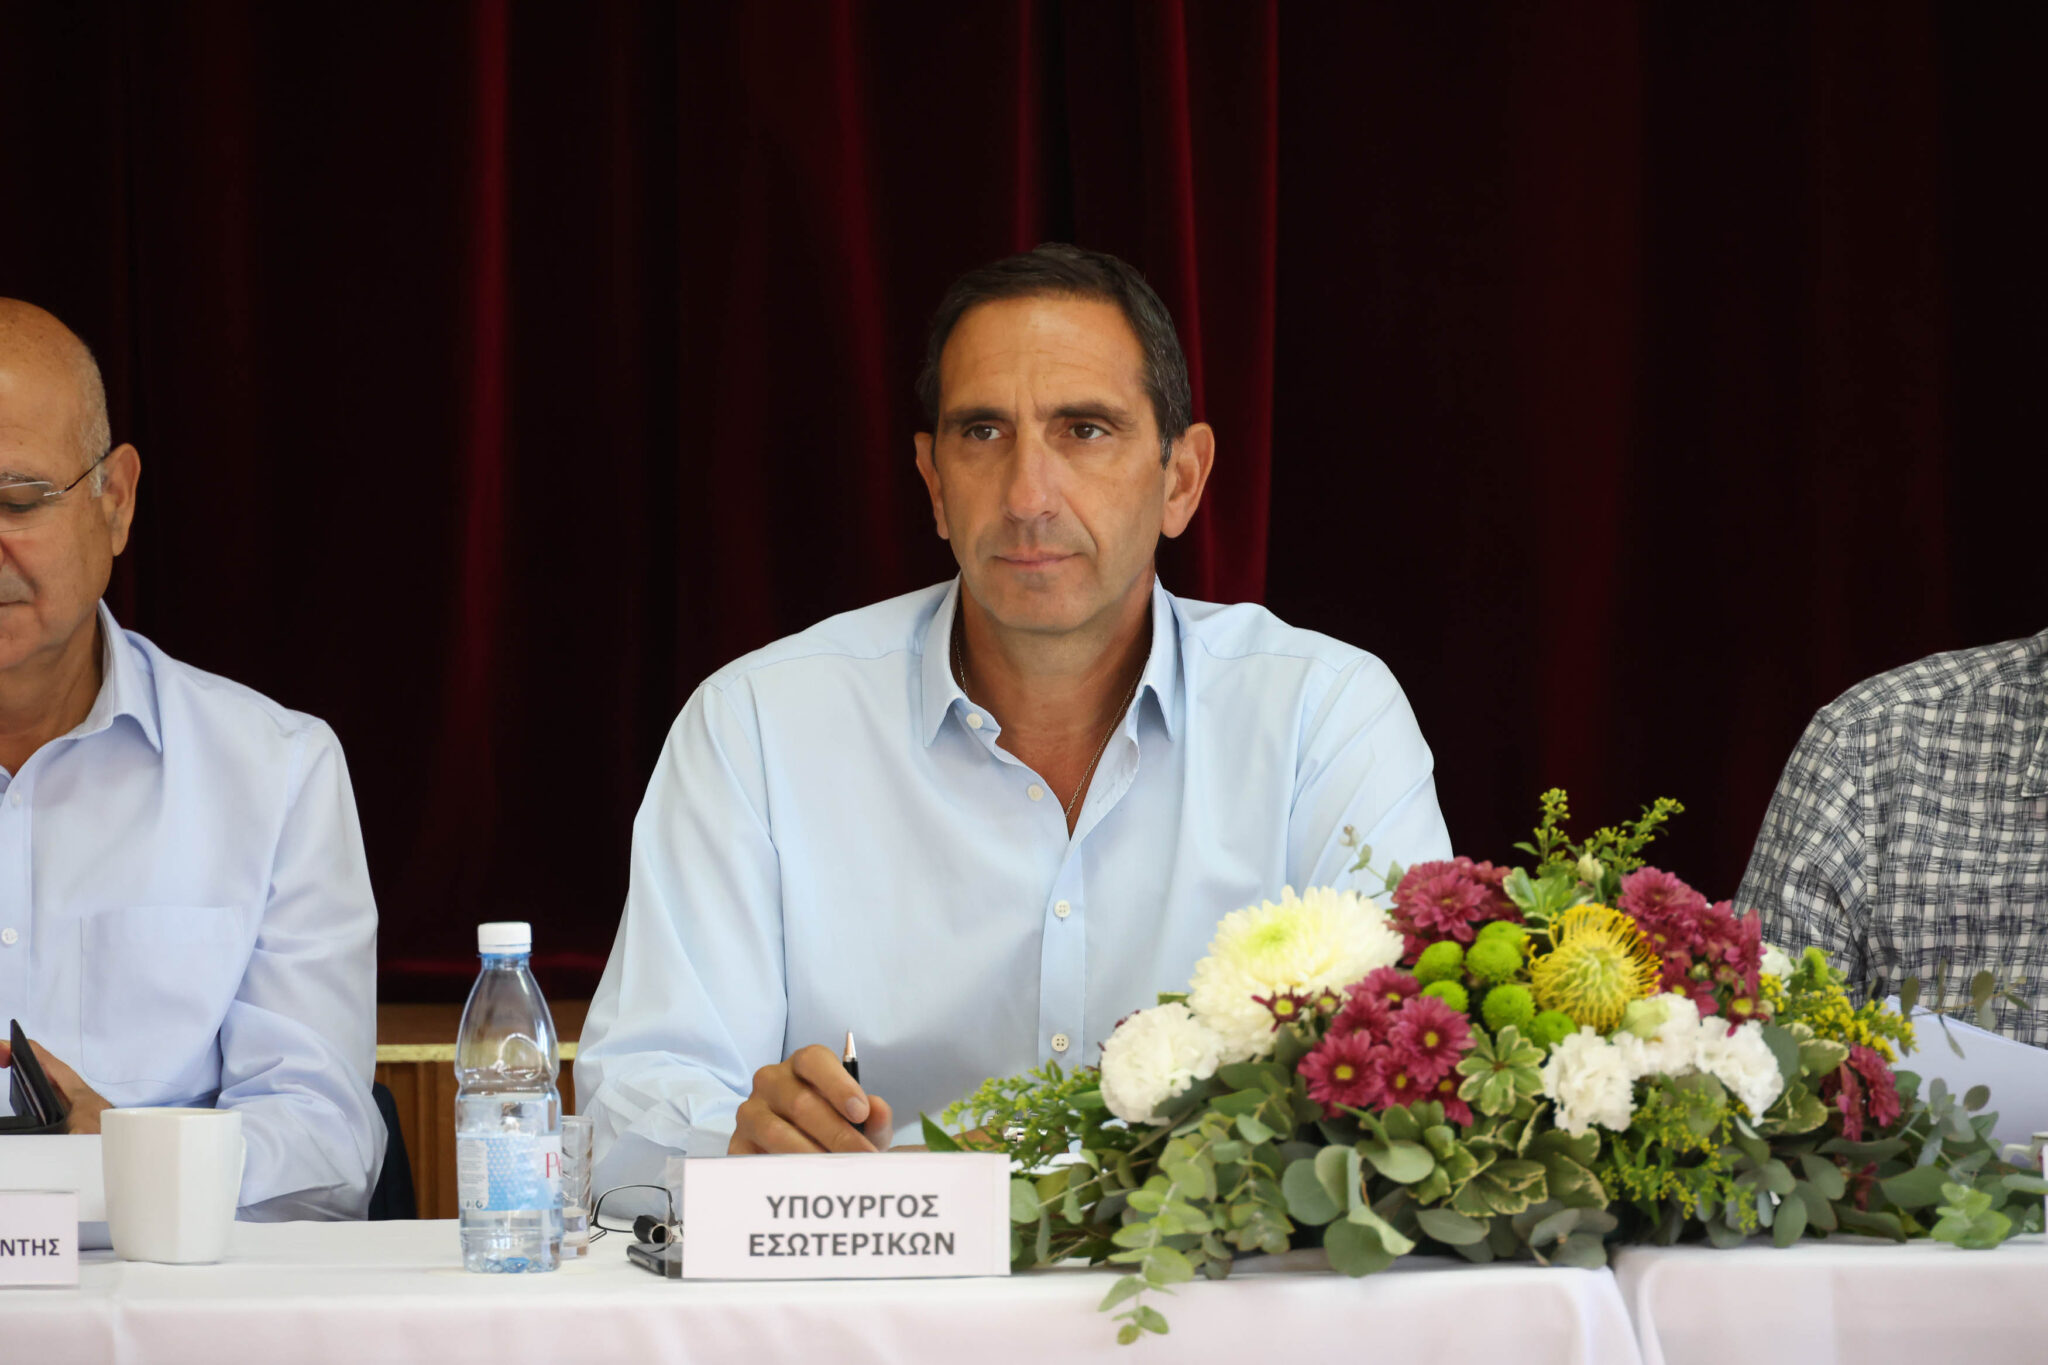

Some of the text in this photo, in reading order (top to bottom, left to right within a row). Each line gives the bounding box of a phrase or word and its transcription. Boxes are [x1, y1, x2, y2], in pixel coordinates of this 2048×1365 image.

[766, 1194, 939, 1219] ΥΠΟΥΡΓΟΣ
[0, 1238, 60, 1256] ΝΤΗΣ
[749, 1232, 955, 1257] ΕΣΩΤΕΡΙΚΩΝ
